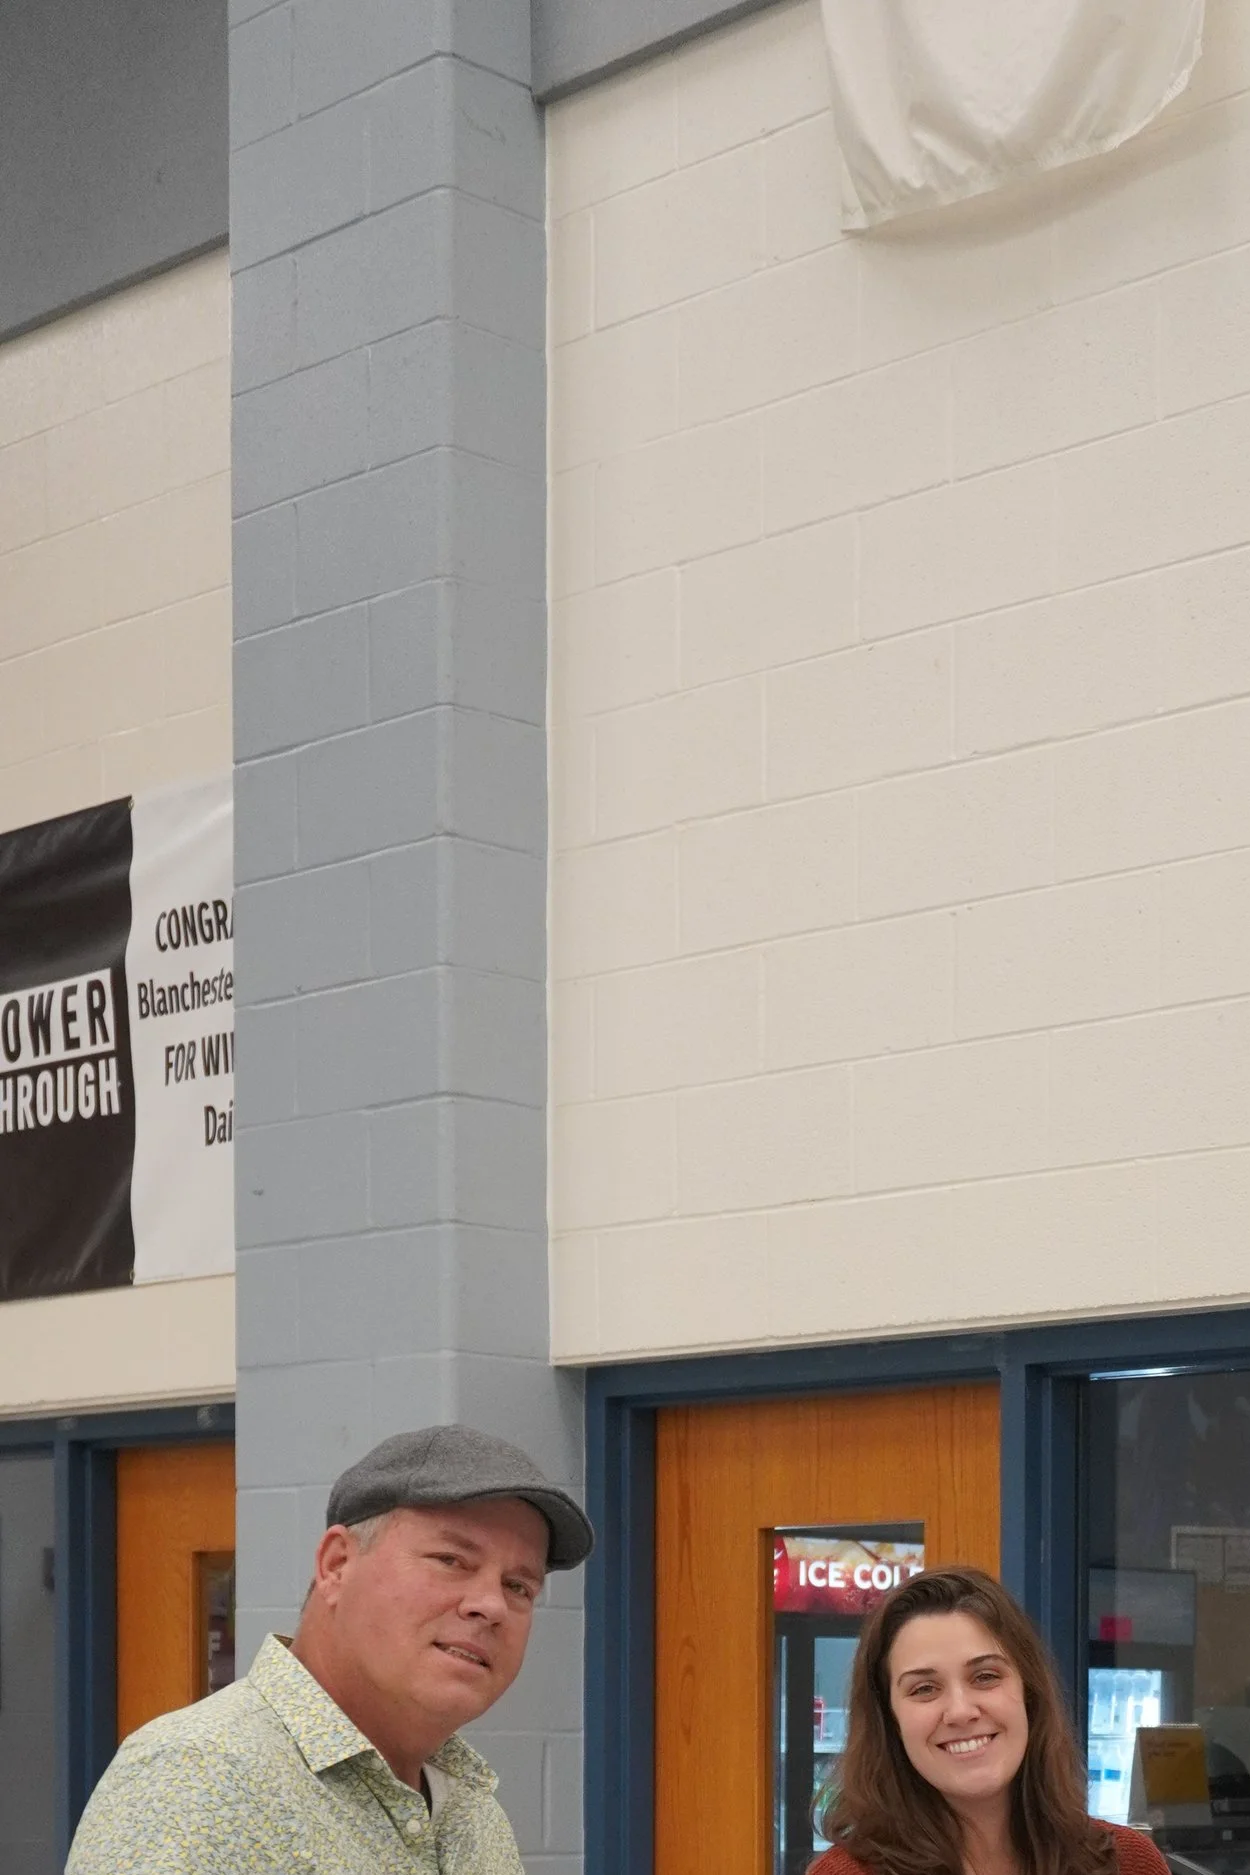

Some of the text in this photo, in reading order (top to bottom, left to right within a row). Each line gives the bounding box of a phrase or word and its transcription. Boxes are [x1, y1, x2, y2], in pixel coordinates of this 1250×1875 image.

[137, 967, 233, 1019] Blancheste
[1, 979, 110, 1063] OWER
[164, 1040, 196, 1086] FOR
[0, 1057, 120, 1134] HROUGH
[204, 1101, 233, 1146] Dai
[798, 1560, 846, 1588] ICE
